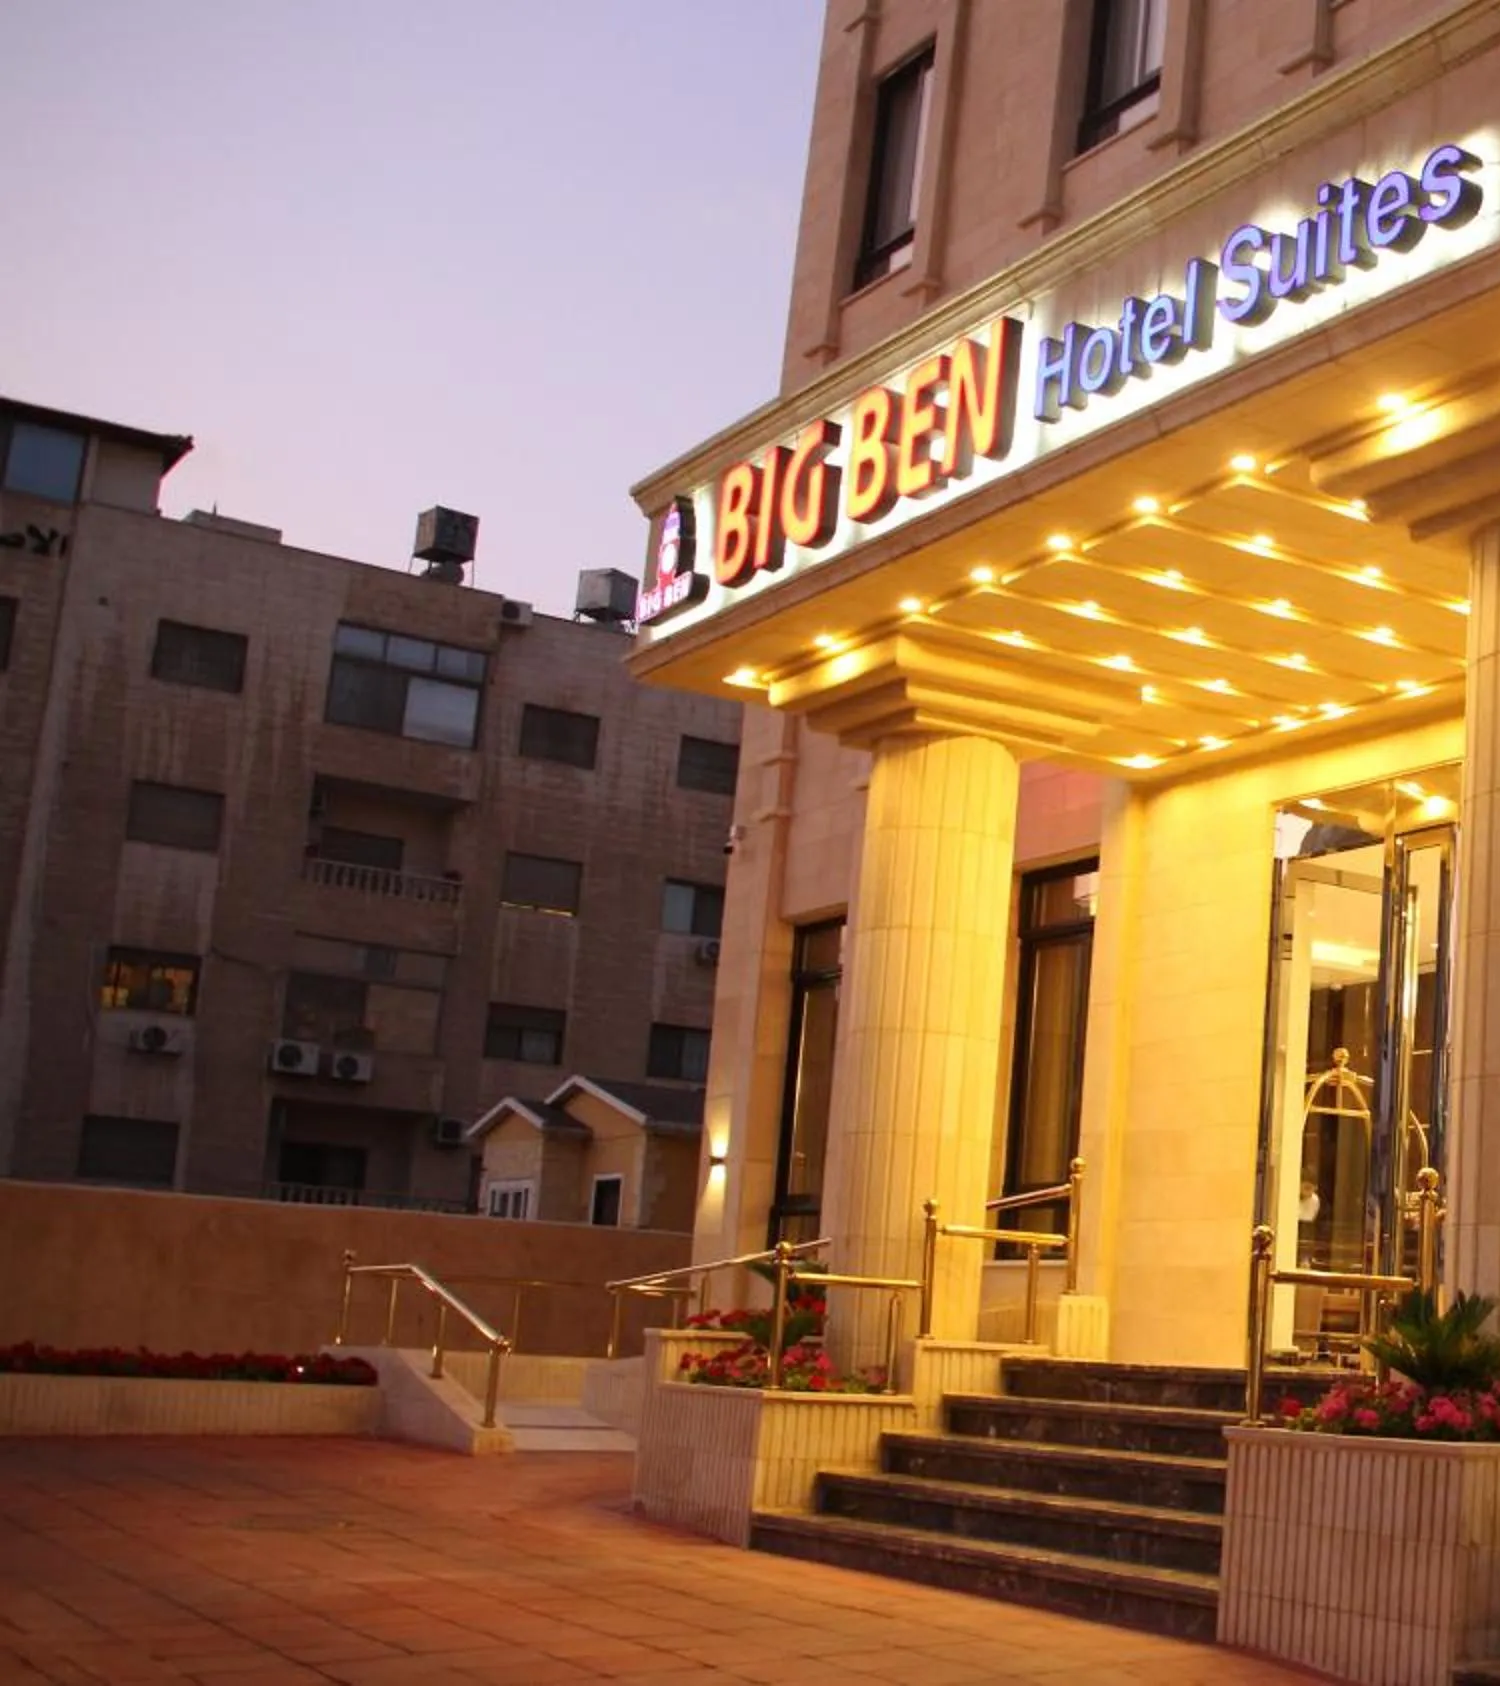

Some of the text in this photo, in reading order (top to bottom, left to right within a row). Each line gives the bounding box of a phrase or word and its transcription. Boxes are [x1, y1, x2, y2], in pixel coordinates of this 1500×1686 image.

[714, 144, 1480, 588] BIG BEN Hotel Suites
